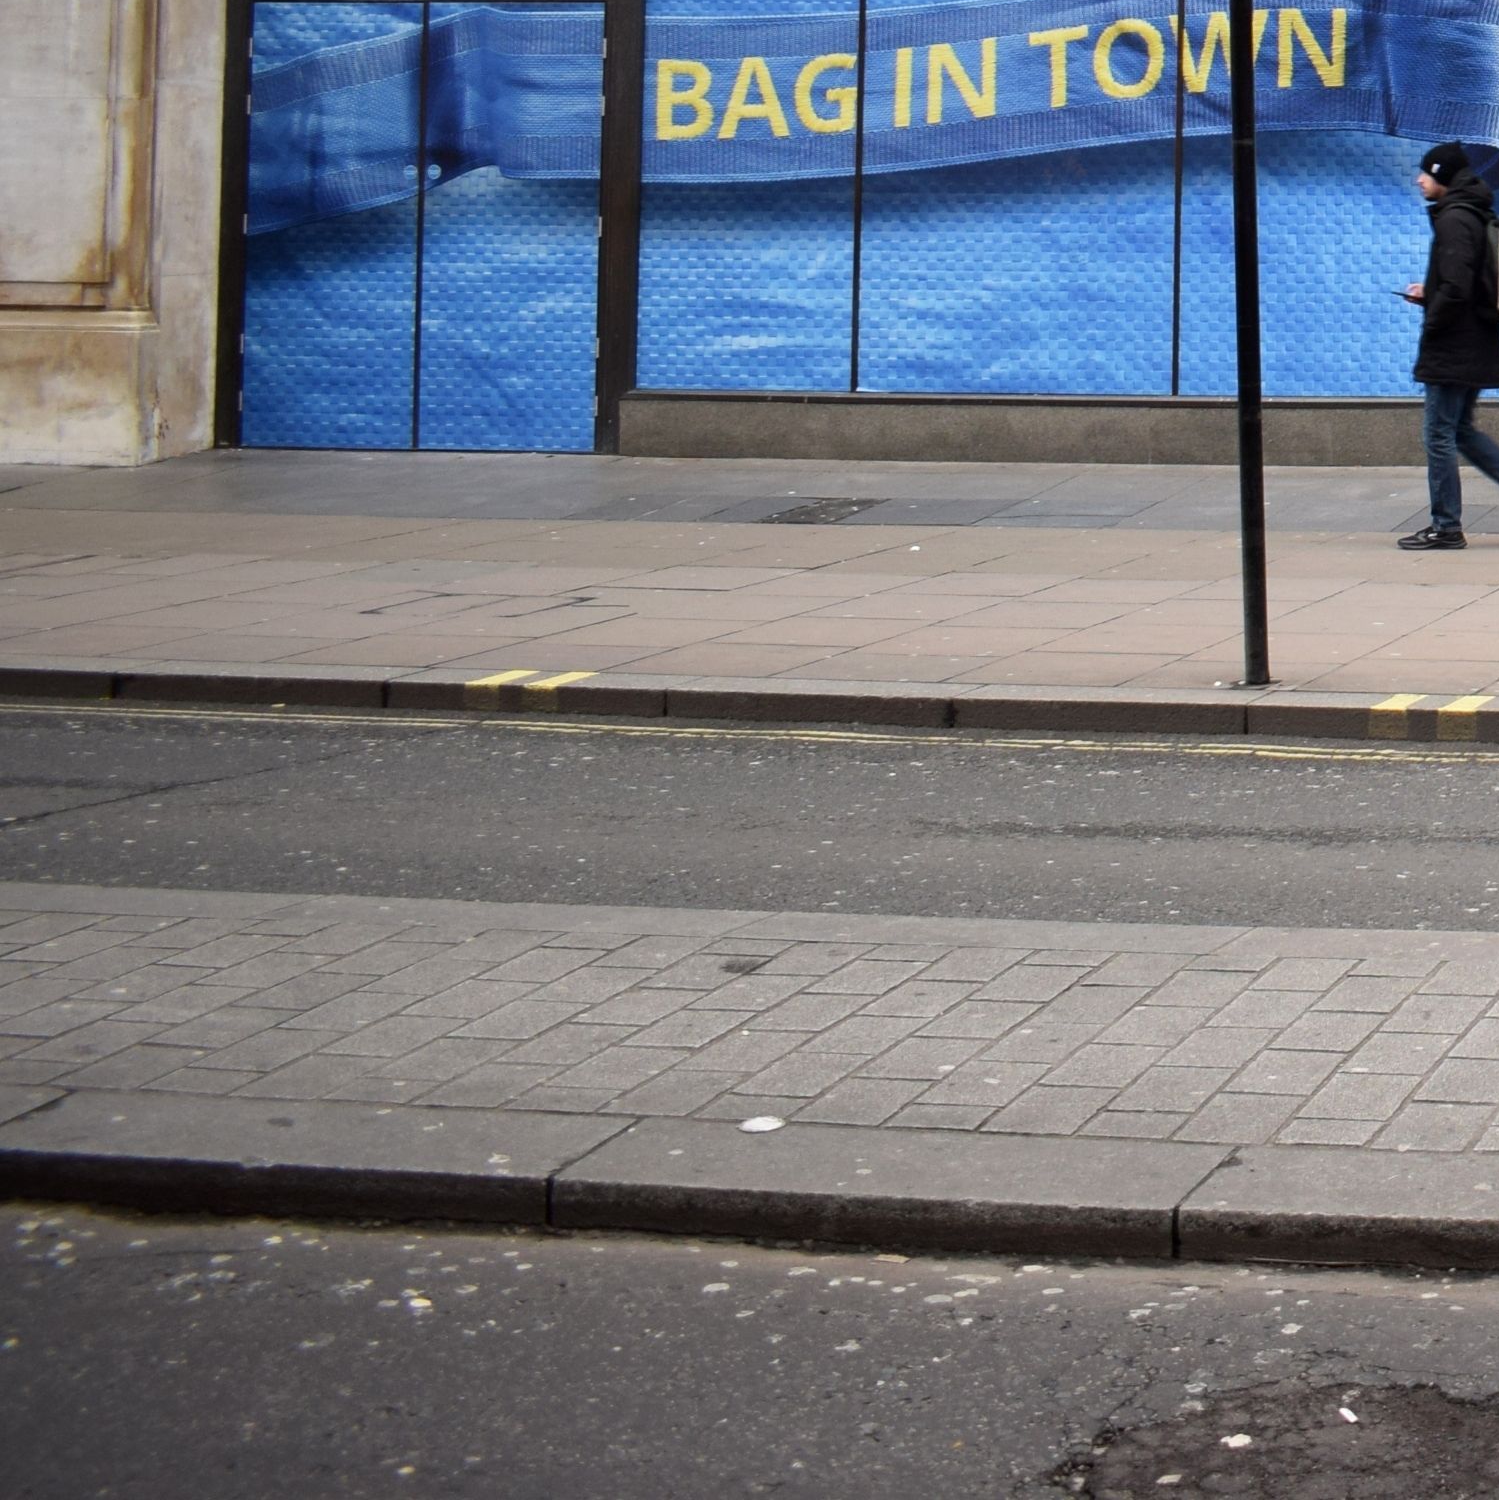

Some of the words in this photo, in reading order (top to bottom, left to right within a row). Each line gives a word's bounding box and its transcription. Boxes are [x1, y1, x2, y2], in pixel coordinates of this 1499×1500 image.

[656, 52, 859, 142] BAG
[895, 37, 996, 129] IN
[1028, 7, 1348, 110] TOWN
